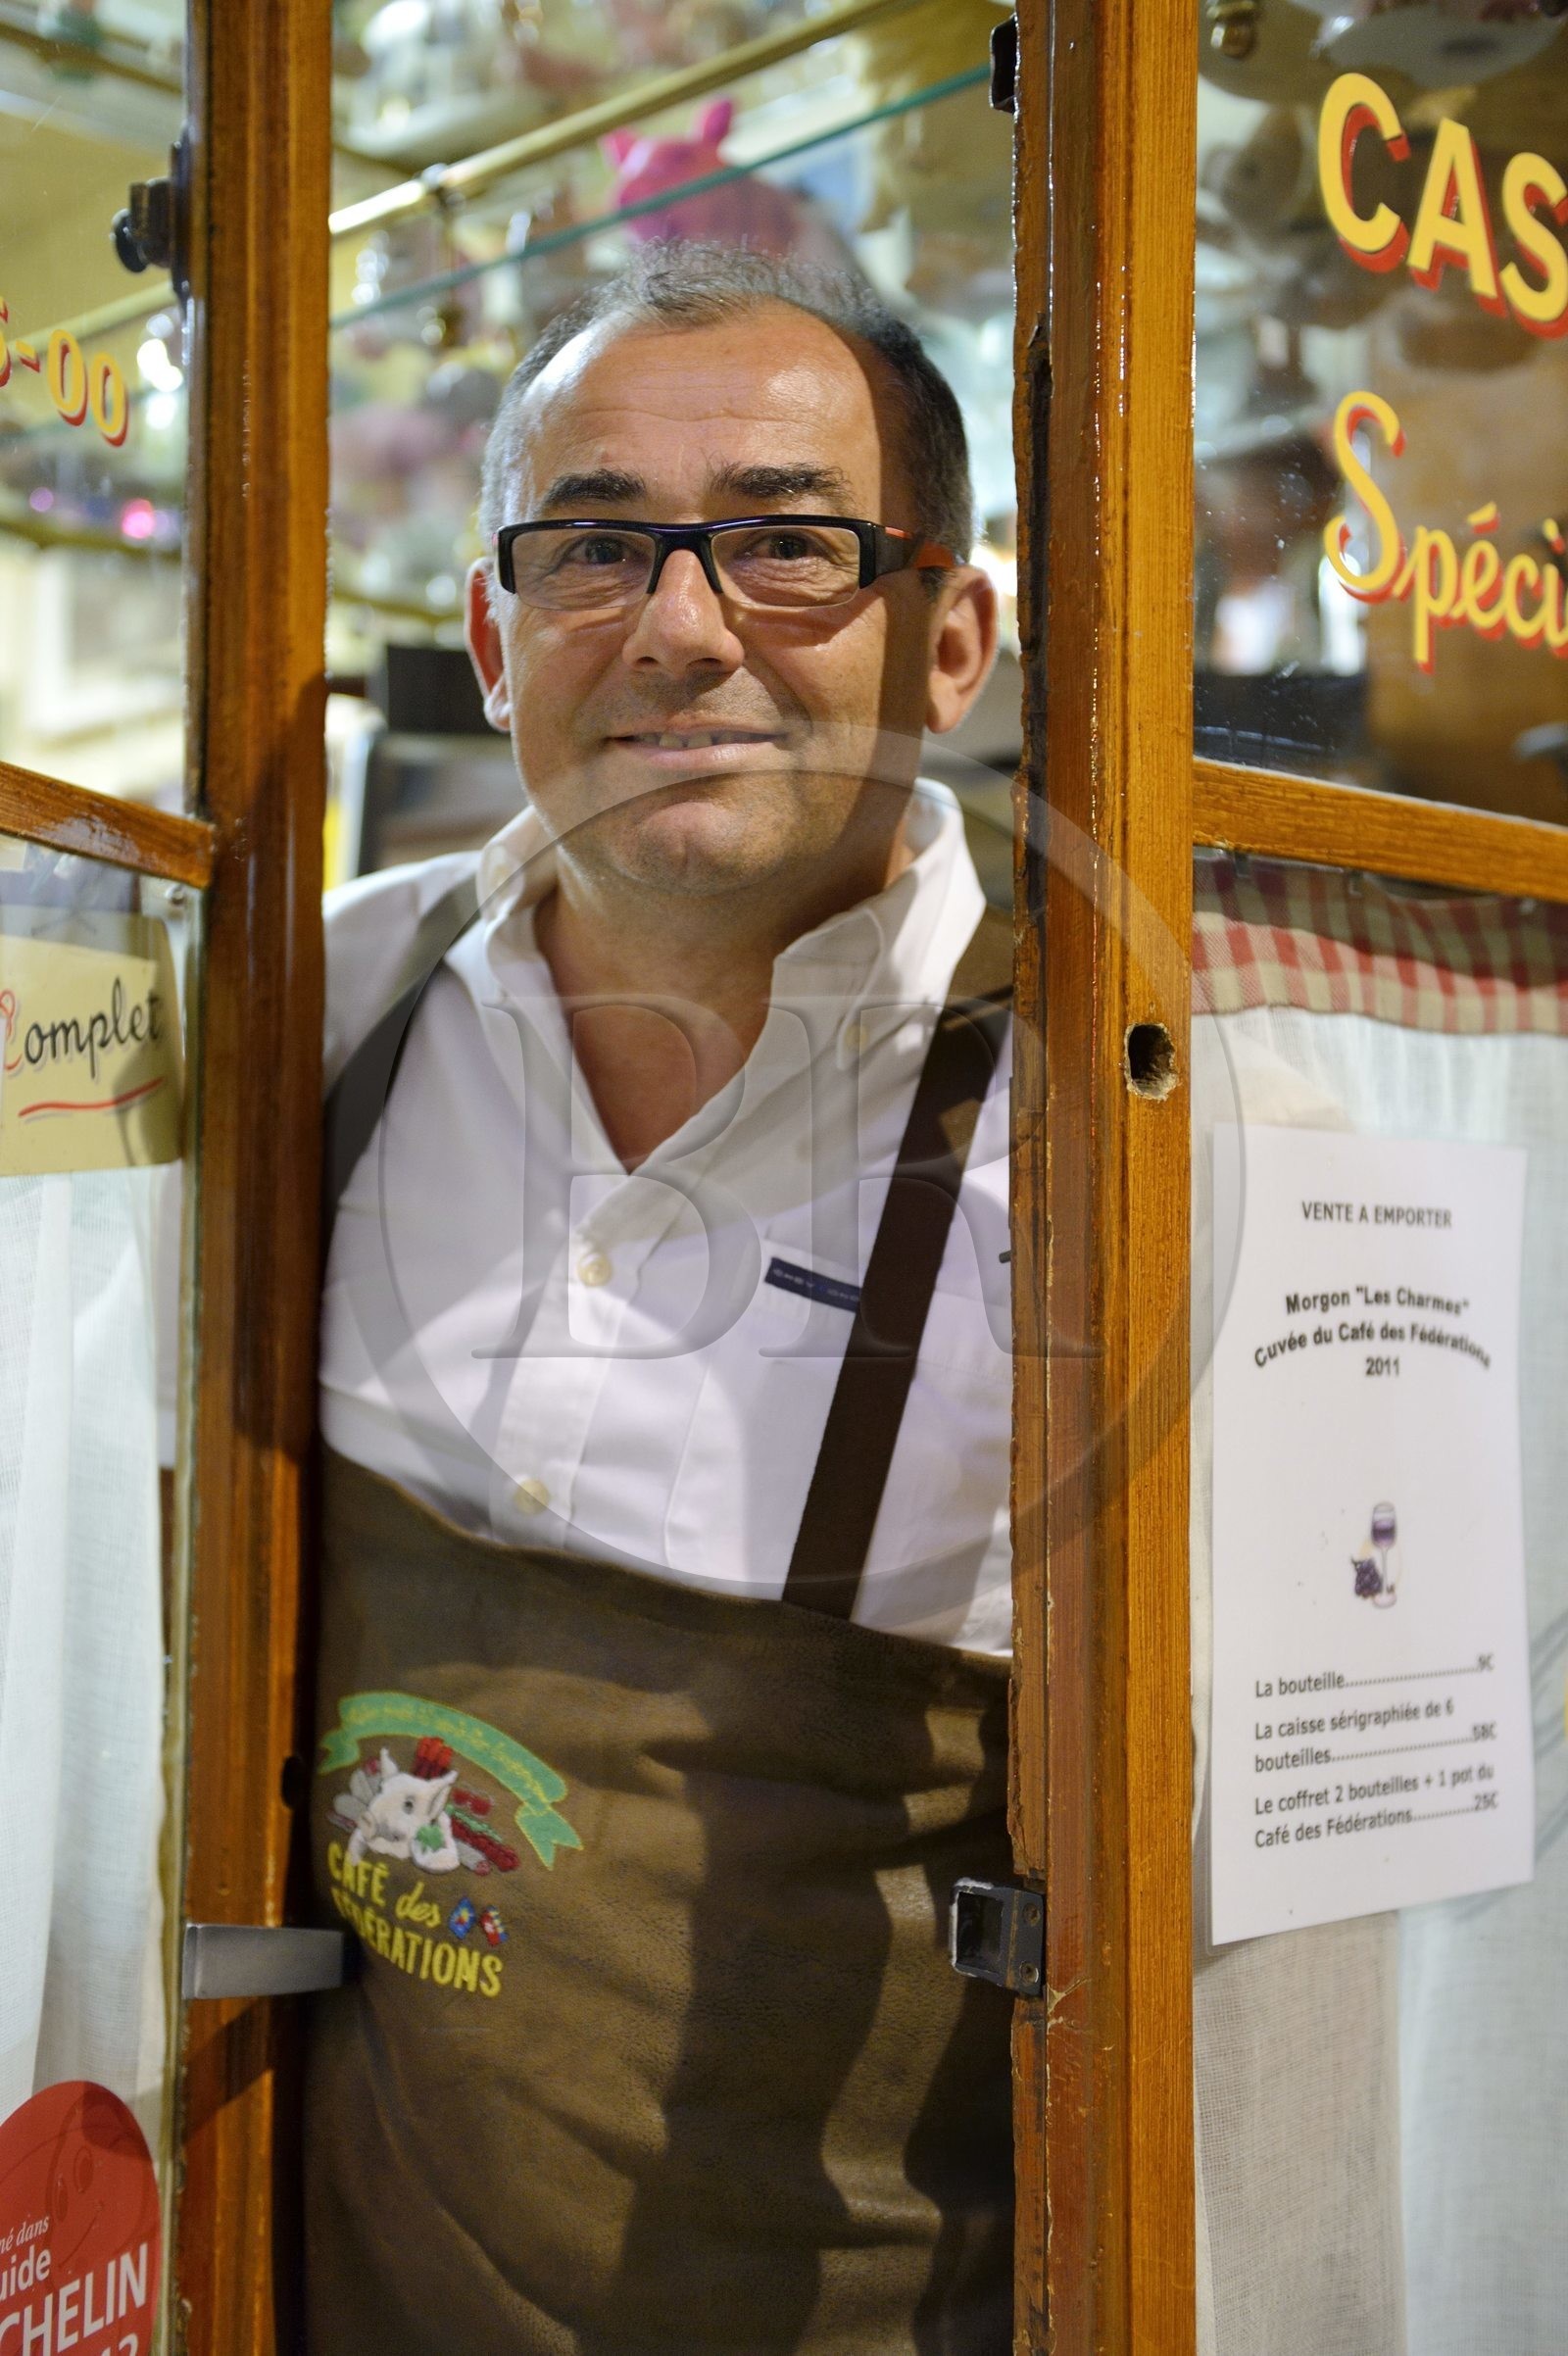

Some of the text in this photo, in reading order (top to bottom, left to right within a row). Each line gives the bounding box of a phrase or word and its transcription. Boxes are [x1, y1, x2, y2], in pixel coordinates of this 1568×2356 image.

[1318, 73, 1568, 338] CAS
[1301, 1201, 1452, 1229] VENTE A EMPORTER
[1285, 1284, 1469, 1316] Morgon "Les Charmes"
[1253, 1321, 1491, 1370] Cuvée du Café des Fédérations
[1364, 1355, 1399, 1377] 2011
[1254, 1680, 1273, 1698] La
[1254, 1696, 1455, 1741] La caisse sérigraphiée de 6
[1254, 1797, 1273, 1815] Le
[1278, 1789, 1330, 1813] coffret
[1335, 1785, 1345, 1804] 2
[1348, 1775, 1420, 1802] bouteilles
[1439, 1770, 1447, 1789] 1
[1451, 1766, 1474, 1790] pot
[1478, 1763, 1495, 1781] du
[1254, 1823, 1291, 1849] Café
[1295, 1822, 1322, 1842] des
[327, 1841, 441, 1928] CAFÉ des
[16, 2216, 50, 2247] dans
